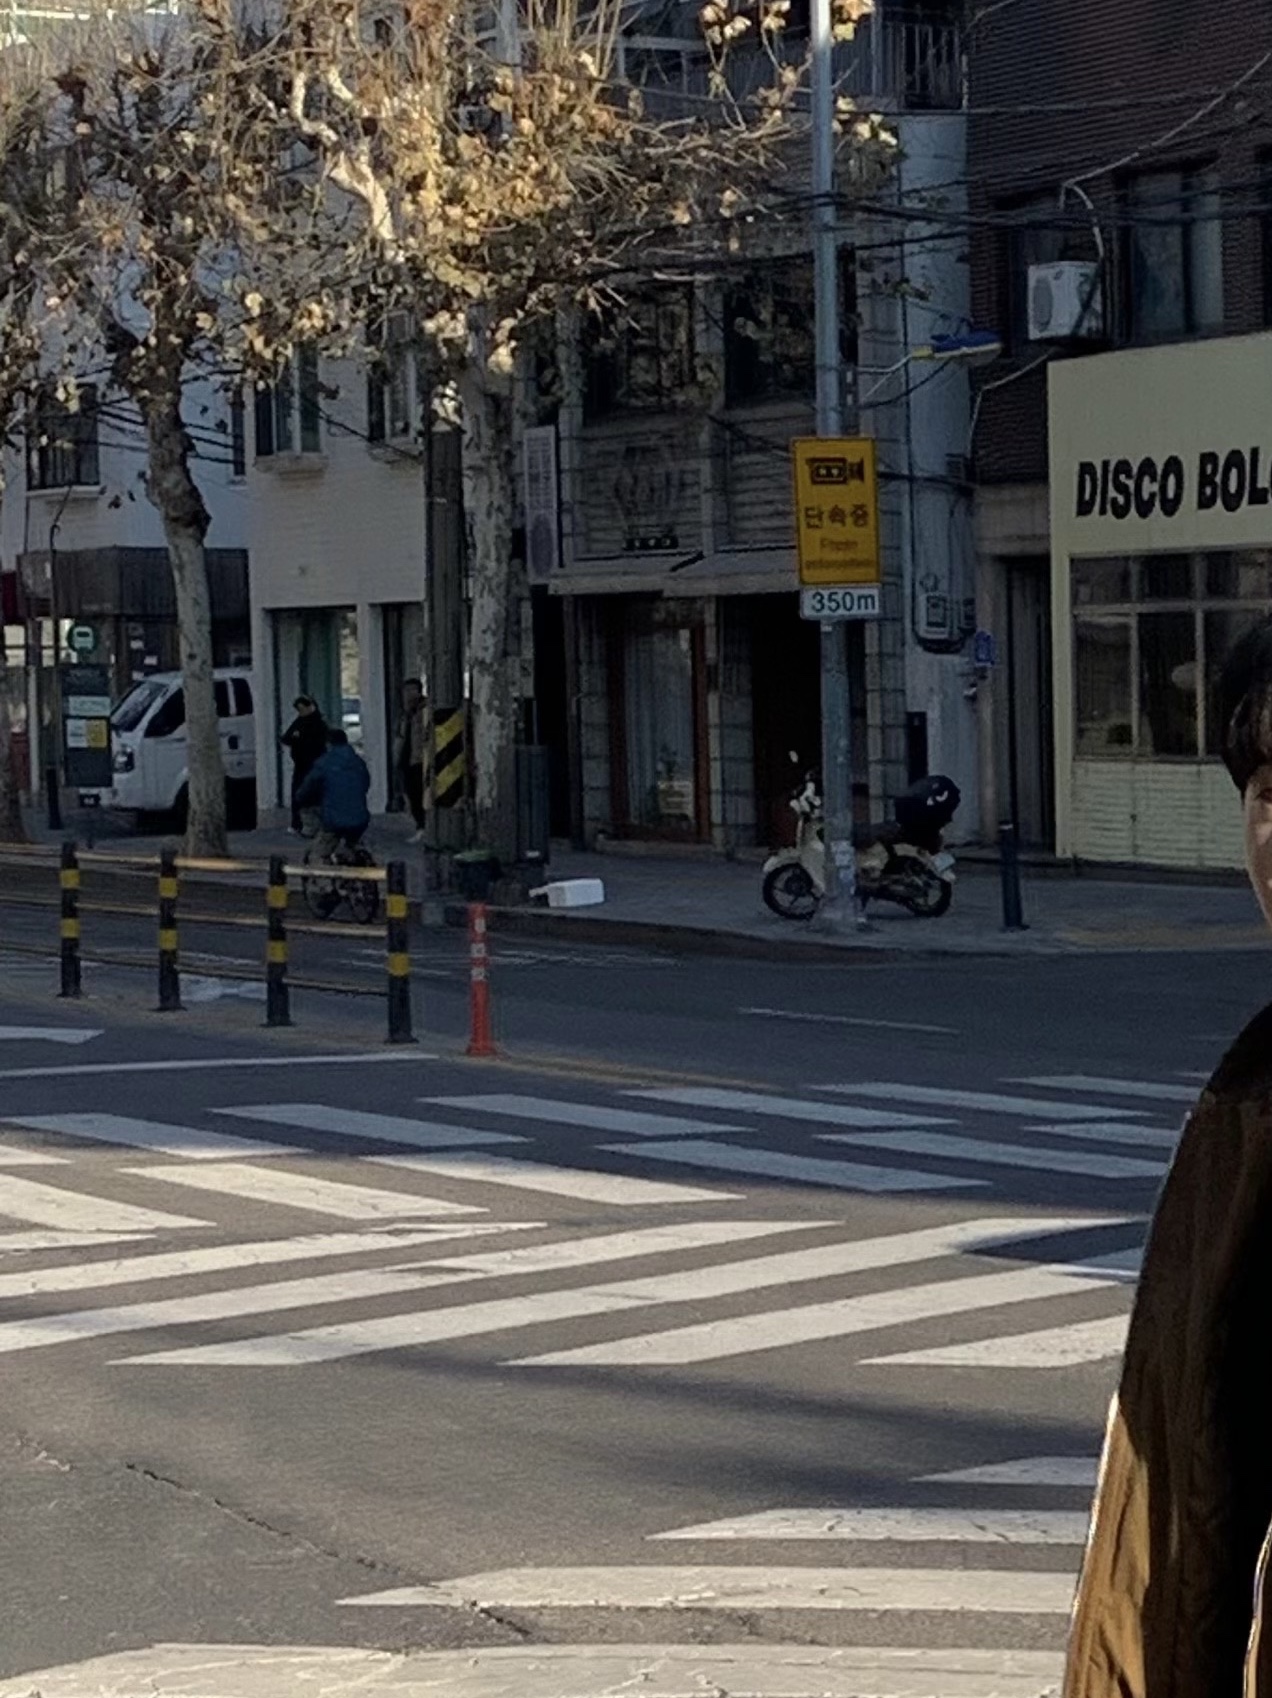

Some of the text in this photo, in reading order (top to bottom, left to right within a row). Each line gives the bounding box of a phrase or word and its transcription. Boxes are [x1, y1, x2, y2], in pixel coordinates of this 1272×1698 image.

[1076, 455, 1184, 520] DISCO
[805, 504, 869, 530] 단속중
[811, 591, 876, 613] 350m
